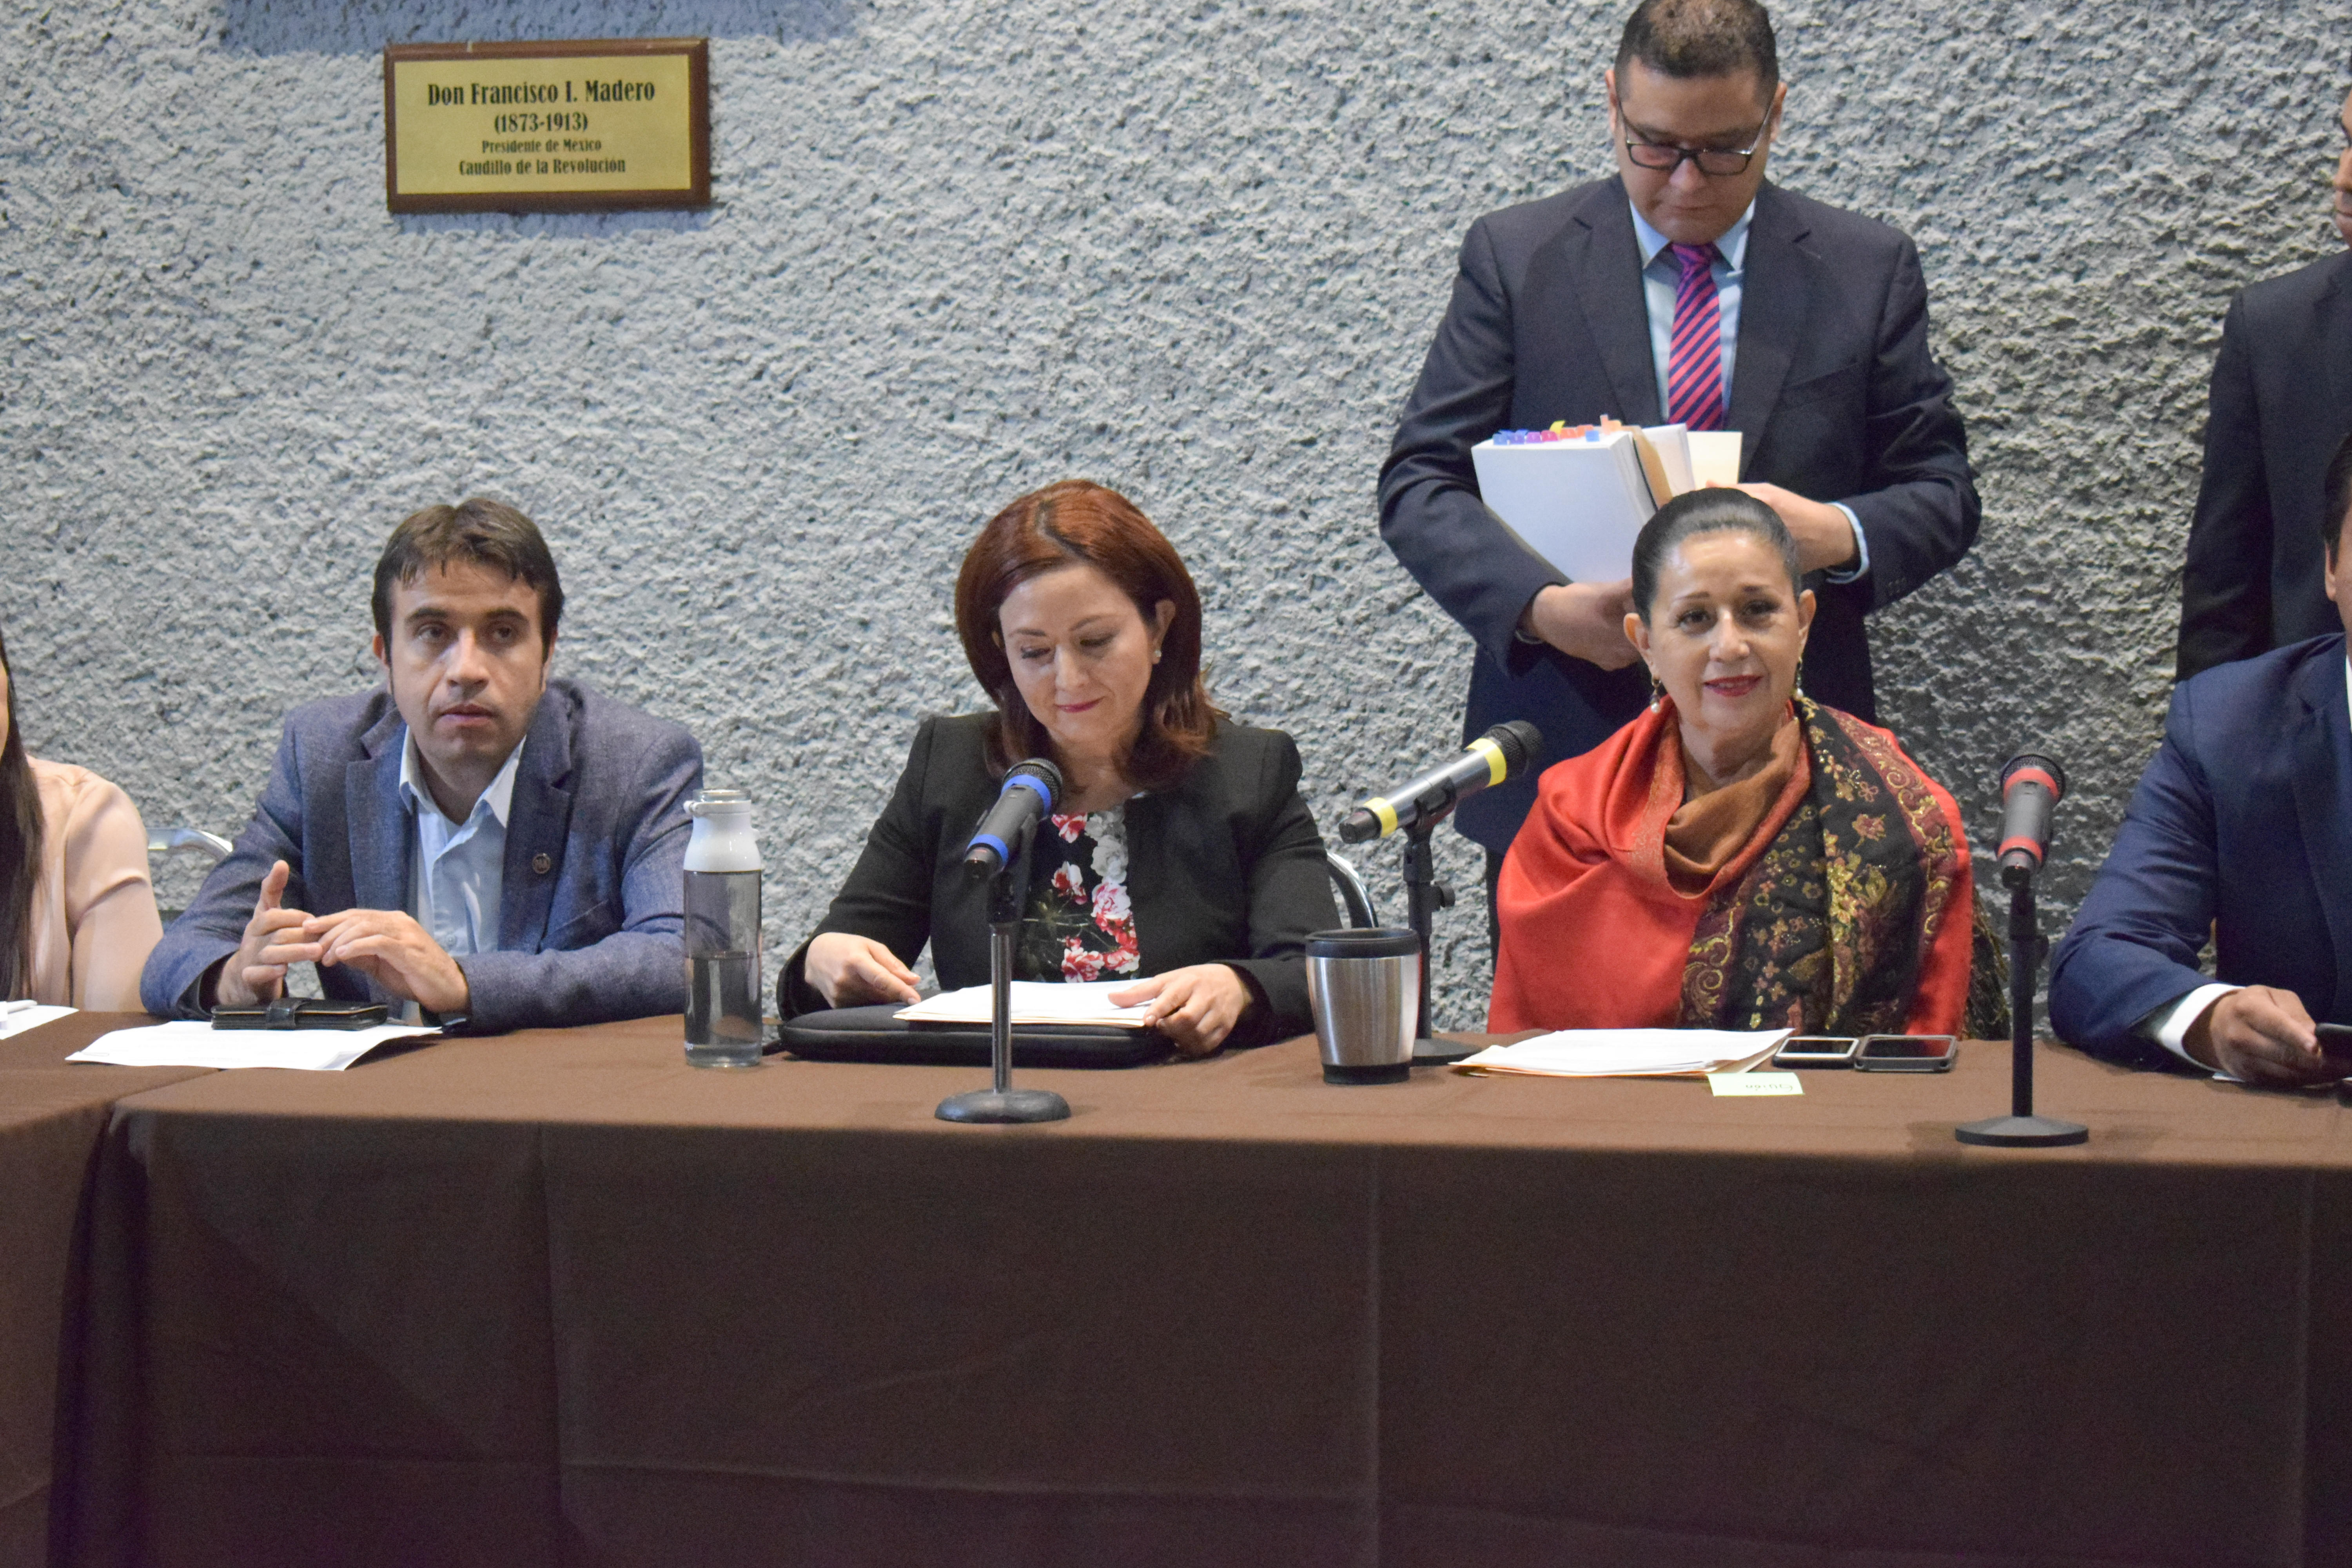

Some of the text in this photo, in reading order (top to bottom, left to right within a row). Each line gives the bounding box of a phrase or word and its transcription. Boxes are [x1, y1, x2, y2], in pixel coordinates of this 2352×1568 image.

[428, 80, 655, 105] Don Francisco I. Madero
[494, 111, 588, 134] (1873-1913)
[482, 140, 542, 153] Presidente
[545, 139, 559, 152] de
[459, 159, 512, 176] Caudillo
[516, 158, 532, 174] de
[536, 158, 548, 174] la
